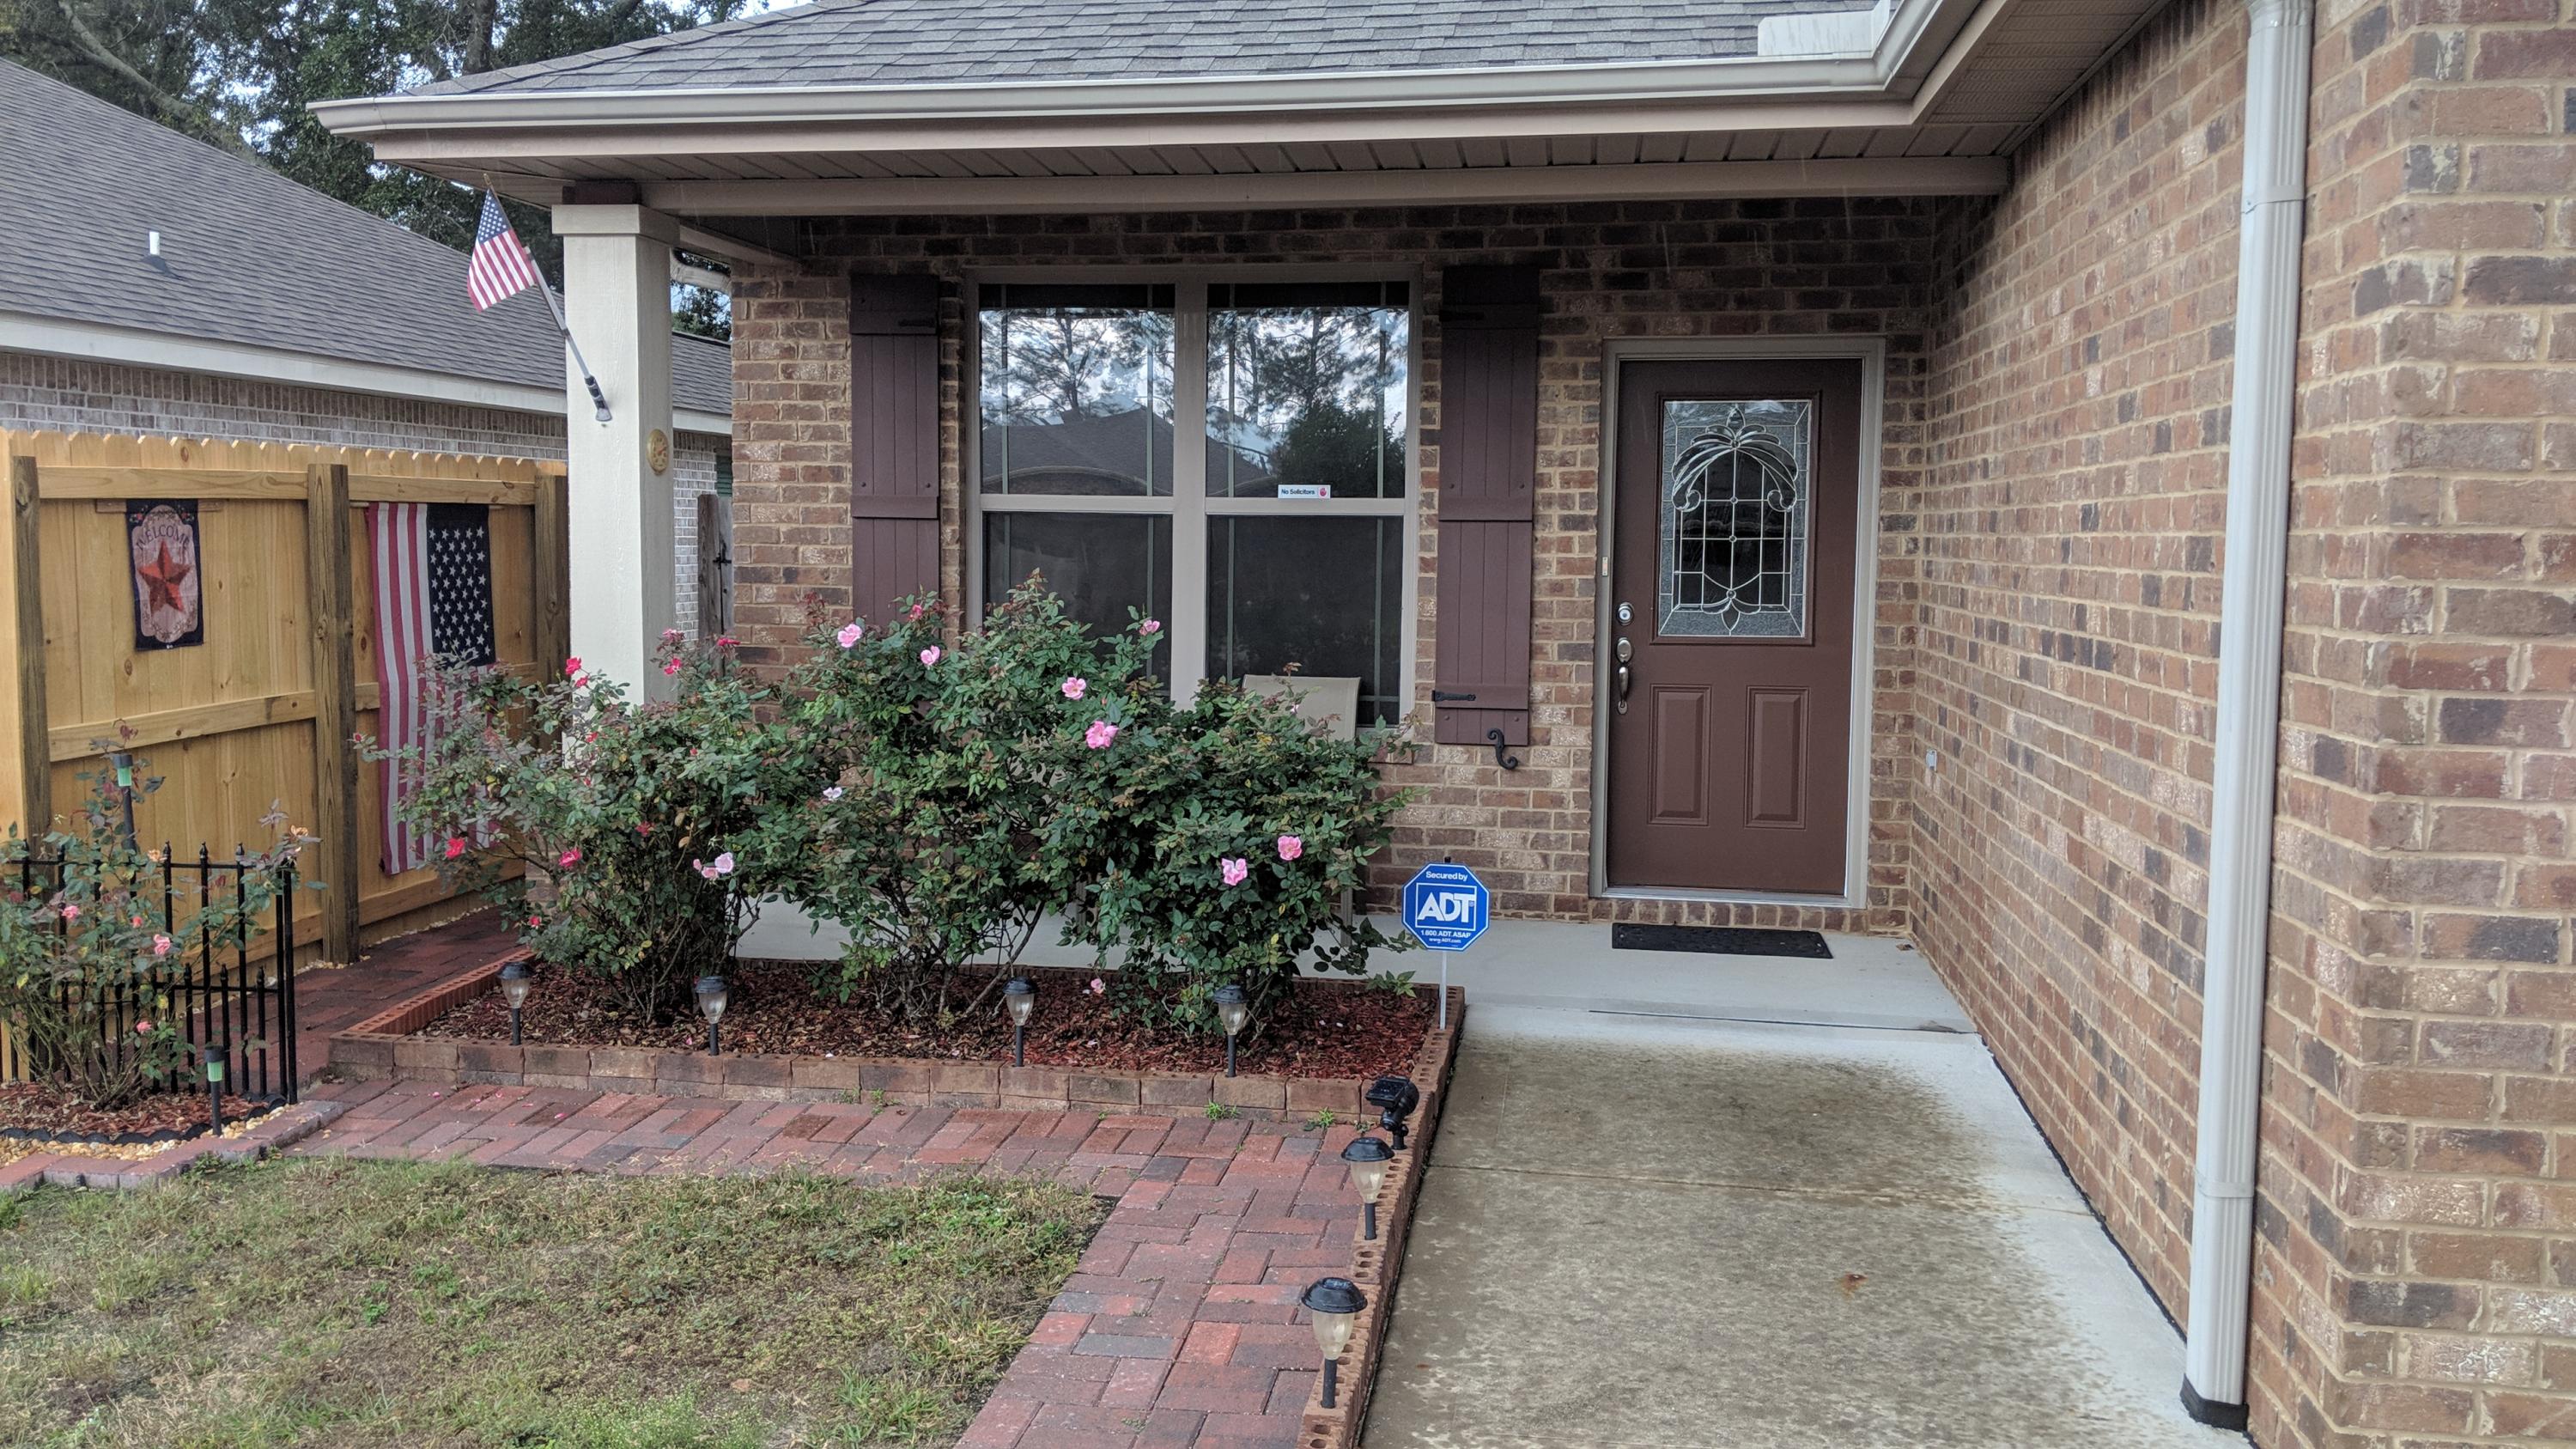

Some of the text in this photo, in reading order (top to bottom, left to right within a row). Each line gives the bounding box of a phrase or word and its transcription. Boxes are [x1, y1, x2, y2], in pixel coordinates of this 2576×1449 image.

[136, 524, 190, 551] WELCOME
[1425, 871, 1467, 881] Secured by
[1417, 892, 1475, 922] ADT
